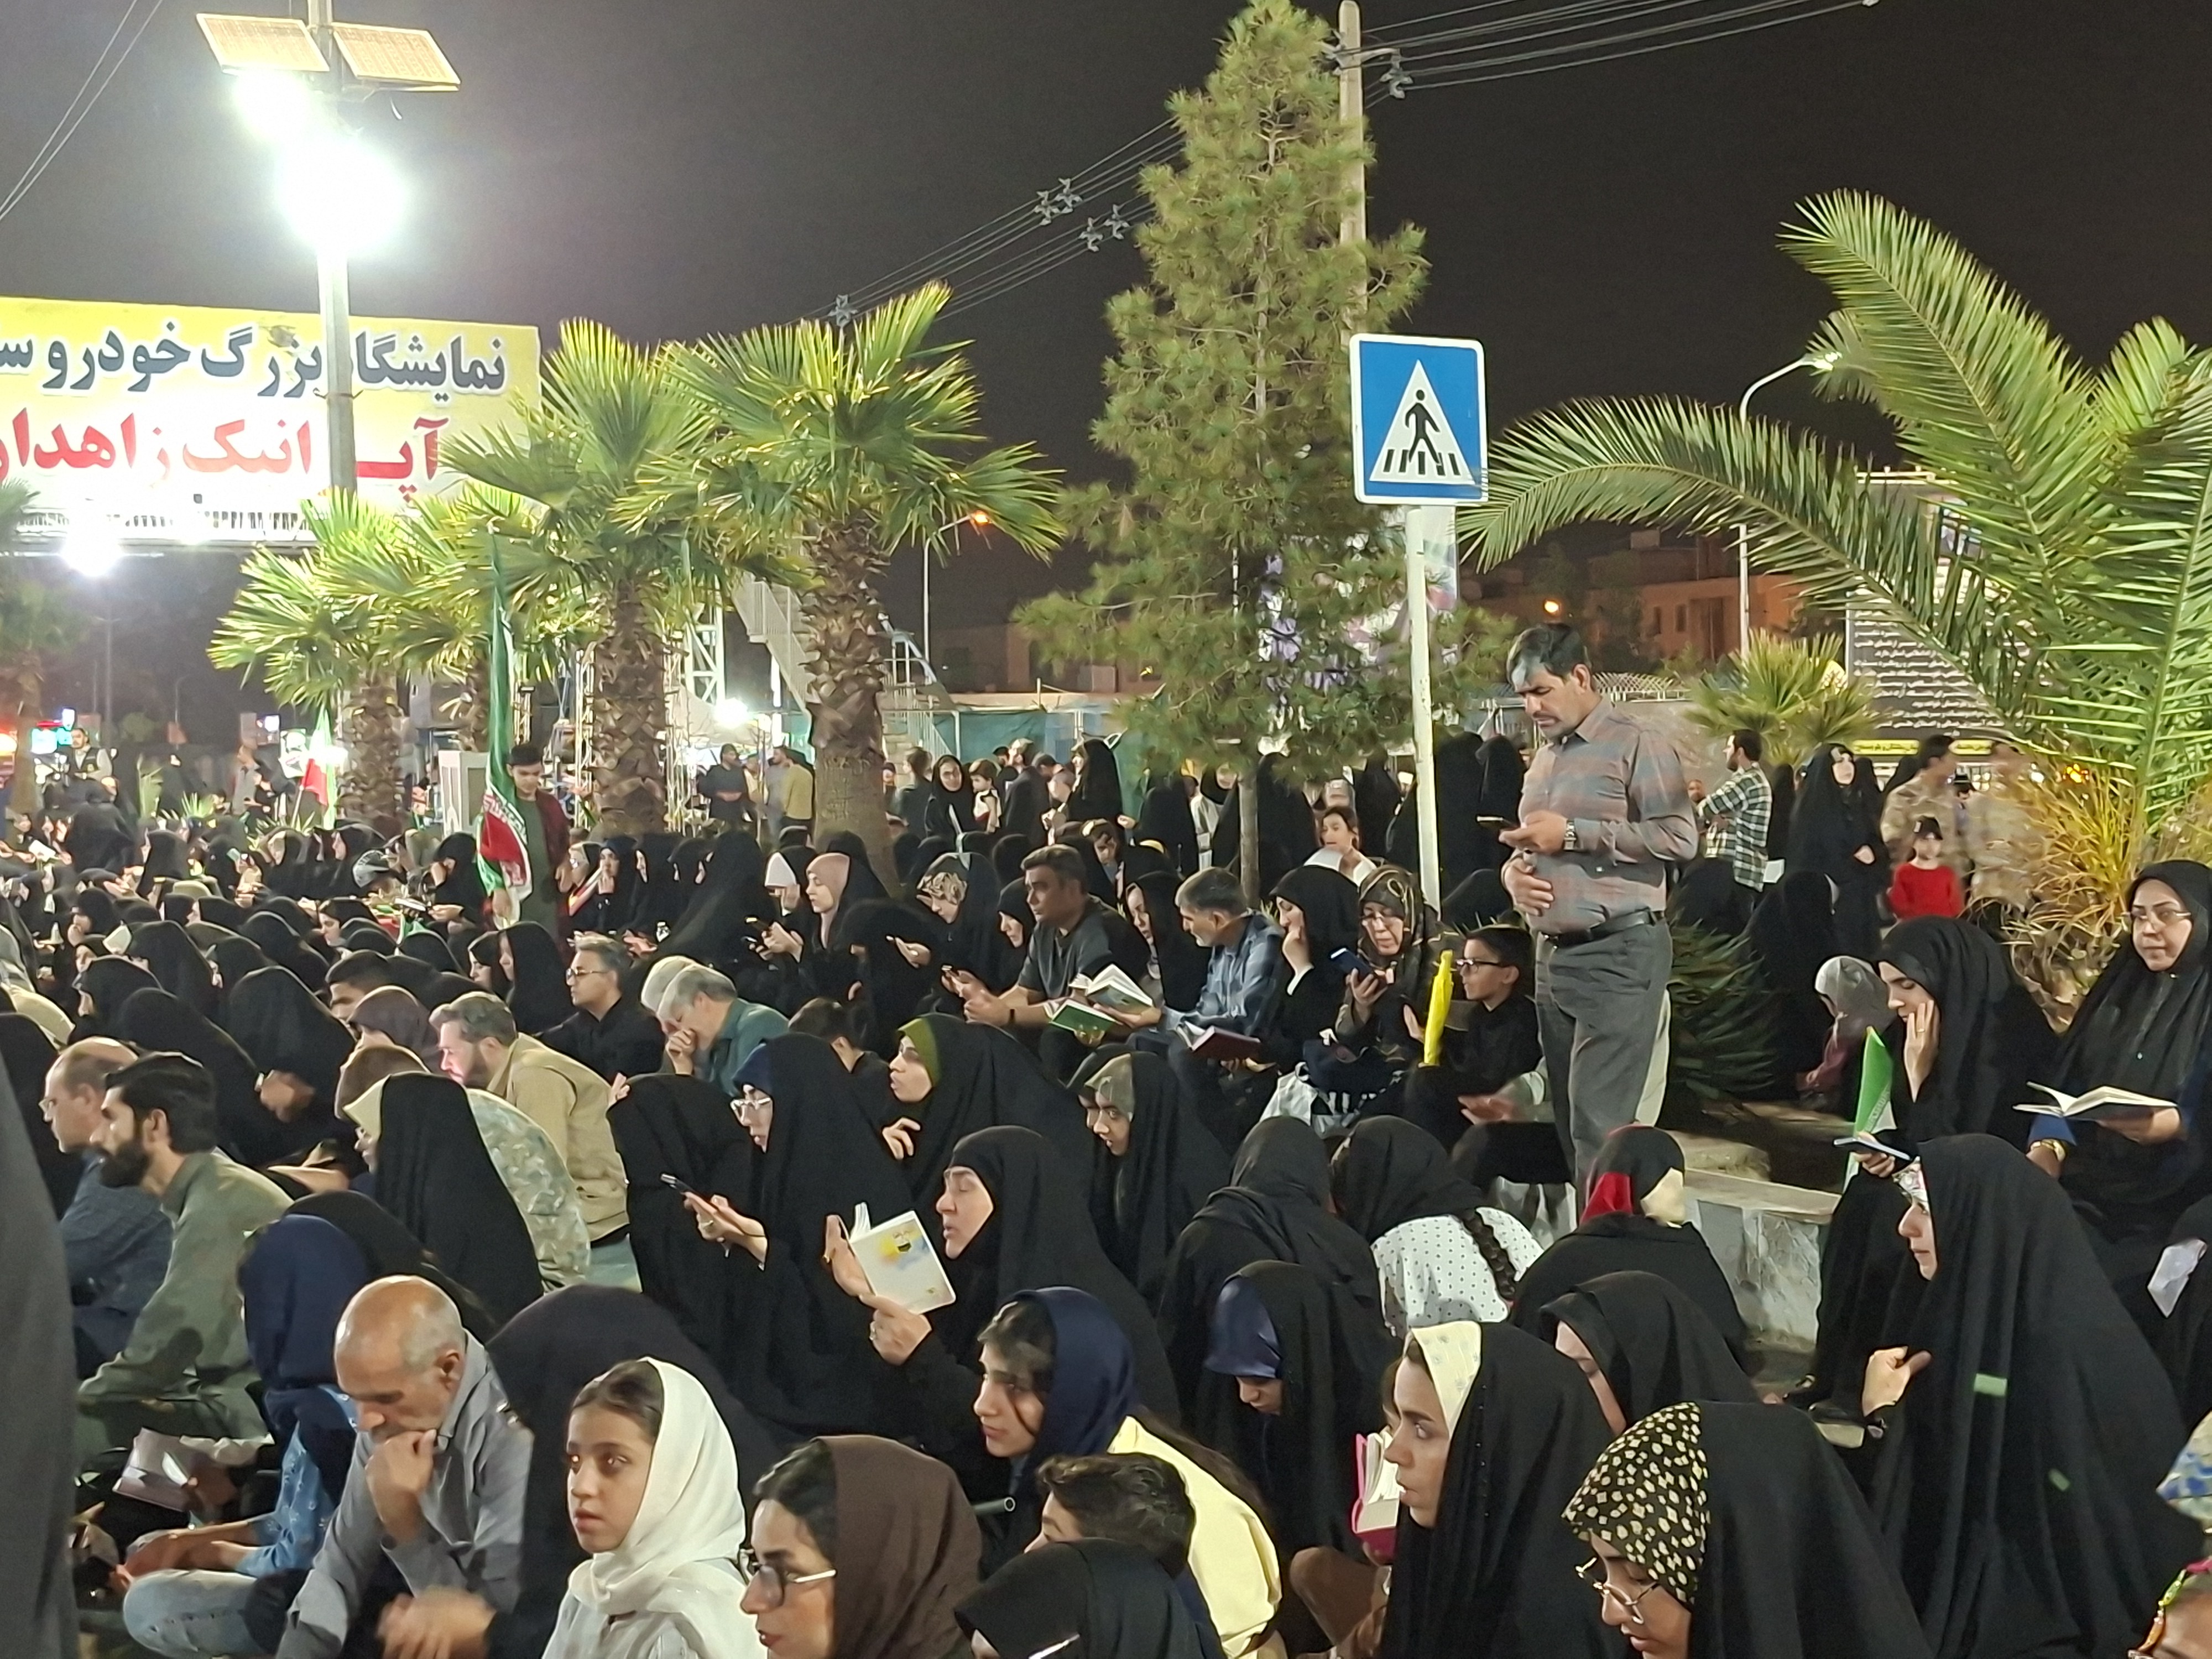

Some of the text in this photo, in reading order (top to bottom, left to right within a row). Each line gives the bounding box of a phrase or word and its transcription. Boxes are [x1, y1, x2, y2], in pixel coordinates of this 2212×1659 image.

[42, 321, 190, 392] خودرو
[201, 327, 322, 398] بزرگ
[356, 331, 505, 402] نمایشگا
